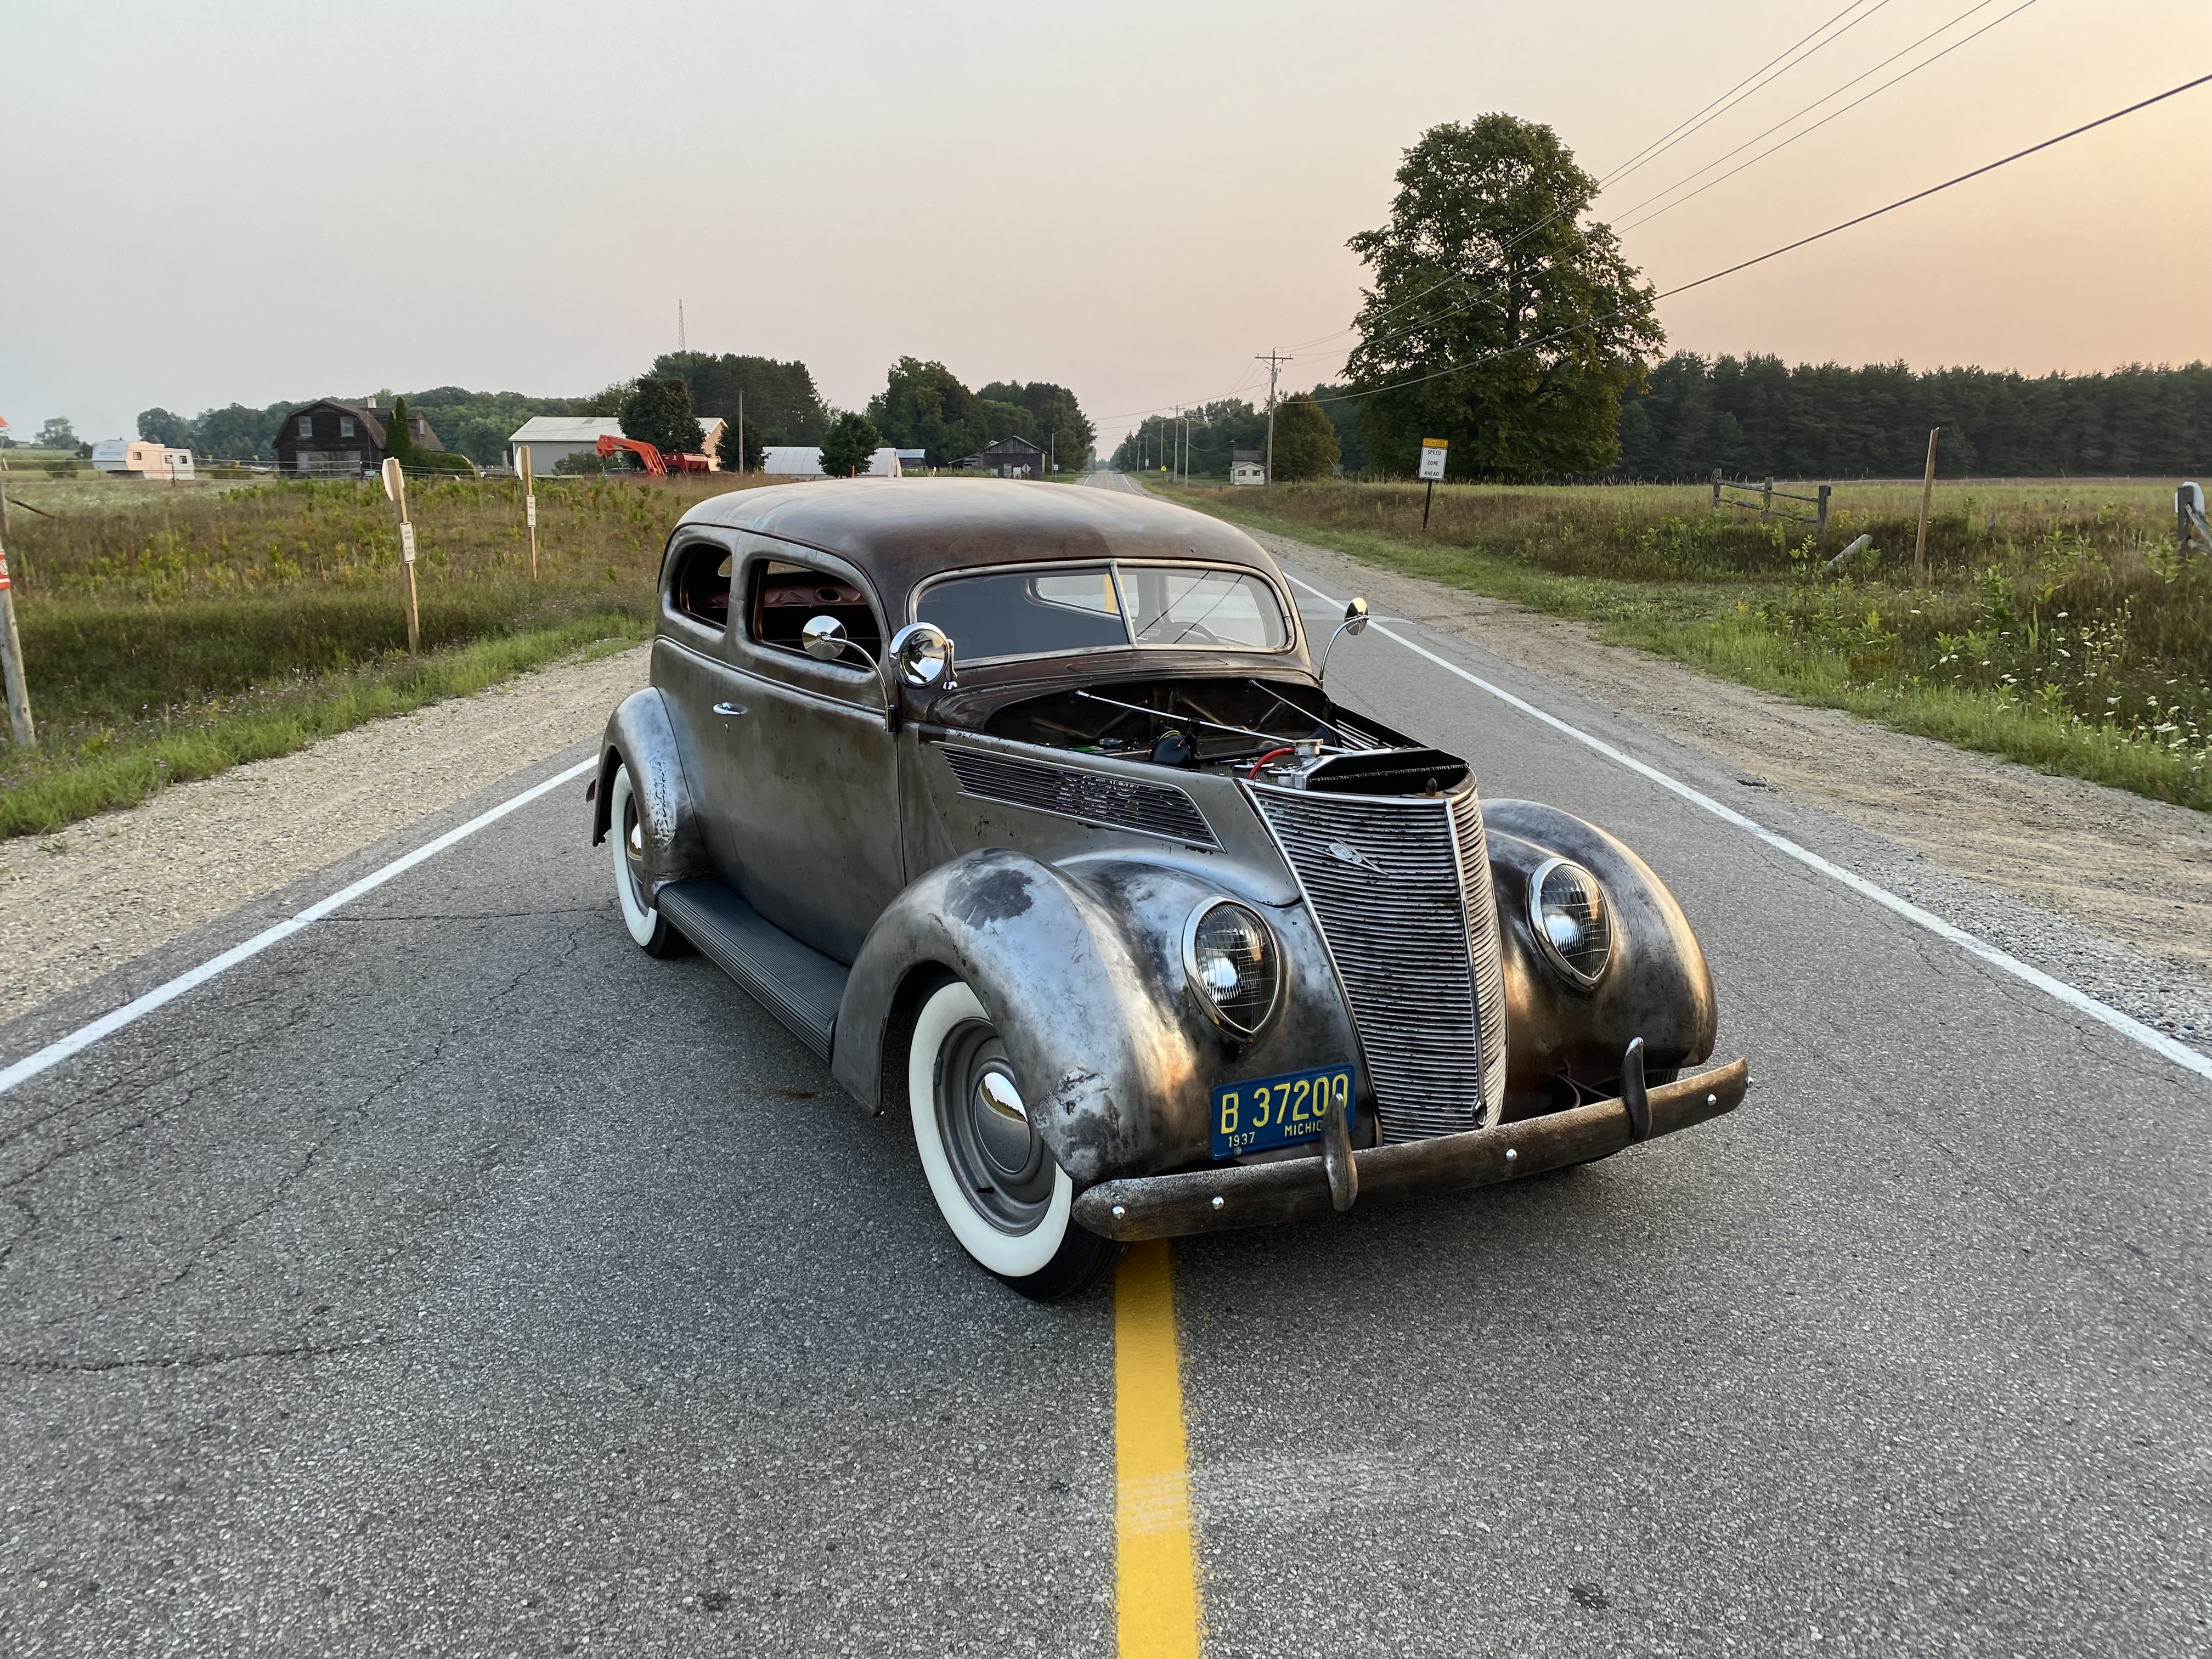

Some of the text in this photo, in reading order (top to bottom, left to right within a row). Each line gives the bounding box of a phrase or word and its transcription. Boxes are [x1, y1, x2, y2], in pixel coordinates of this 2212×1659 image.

[1221, 1074, 1348, 1134] B 37200
[1228, 1120, 1323, 1148] 1937 MICHIG
